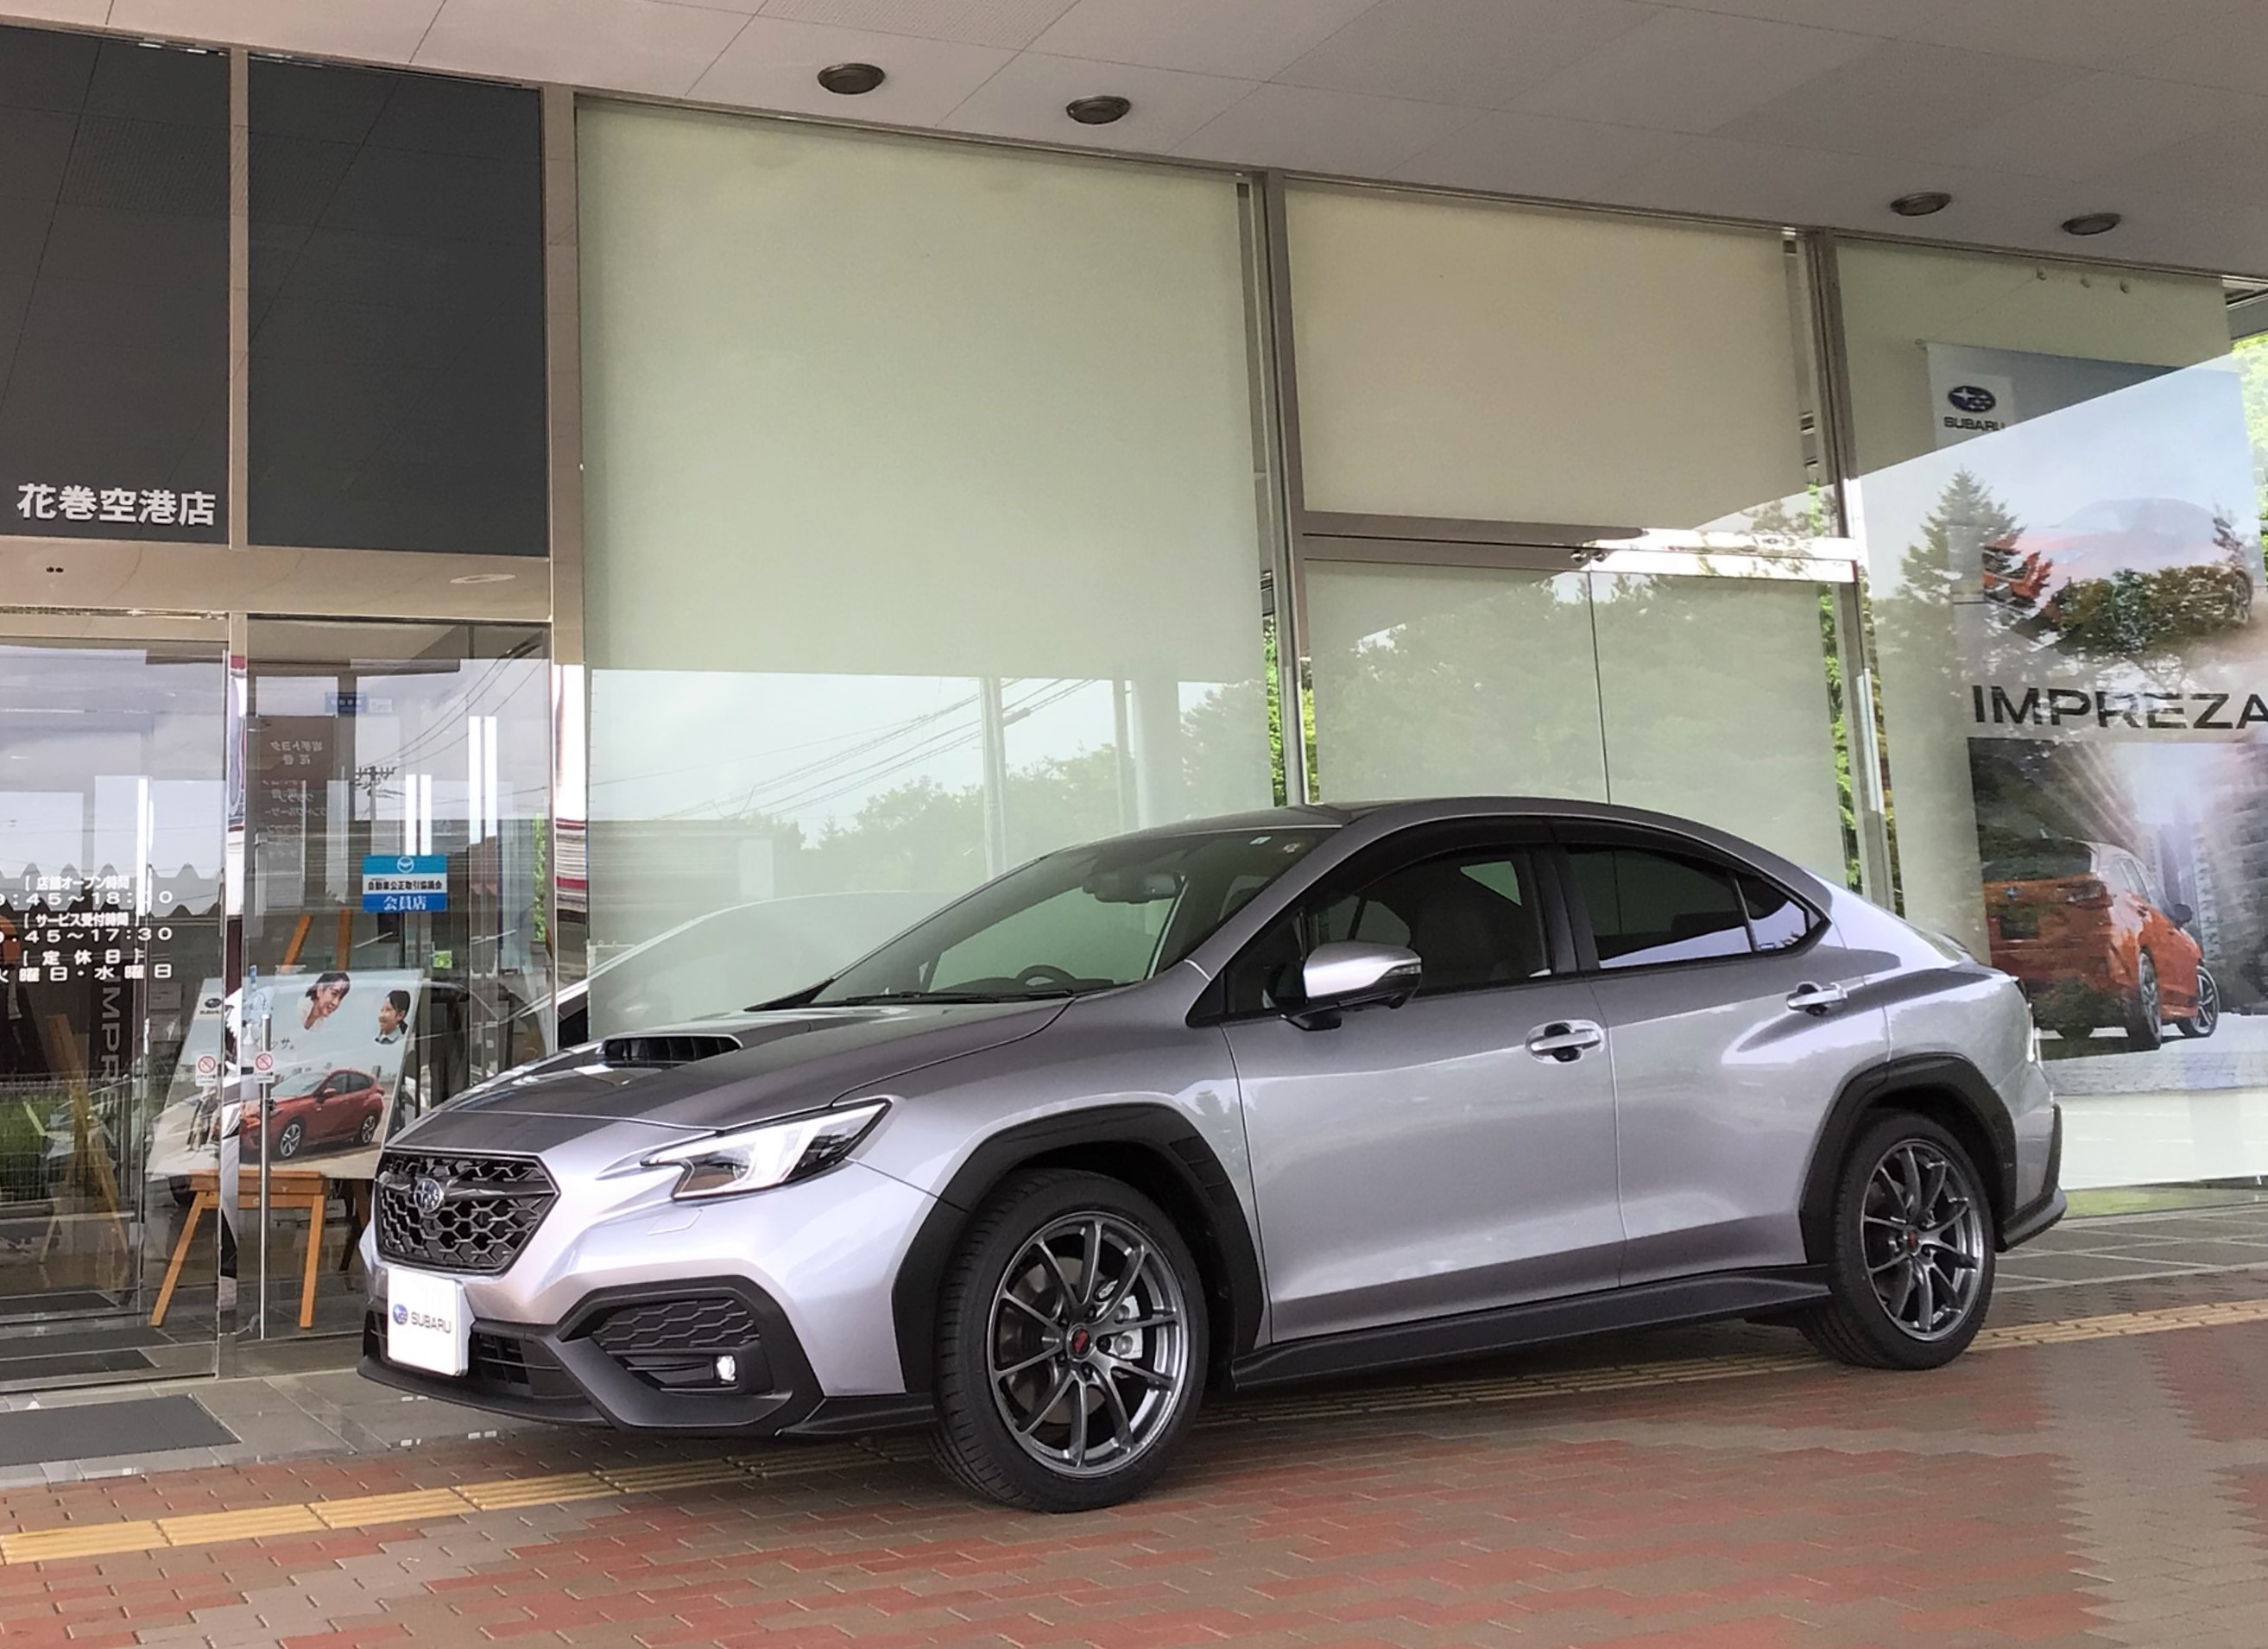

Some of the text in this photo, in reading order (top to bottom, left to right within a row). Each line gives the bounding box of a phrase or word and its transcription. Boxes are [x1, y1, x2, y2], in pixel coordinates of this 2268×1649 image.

[16, 483, 216, 526] 花巻空港店
[1972, 685, 2268, 730] IMPREZA
[383, 894, 427, 912] 会員店
[411, 1311, 452, 1334] SUBARU
